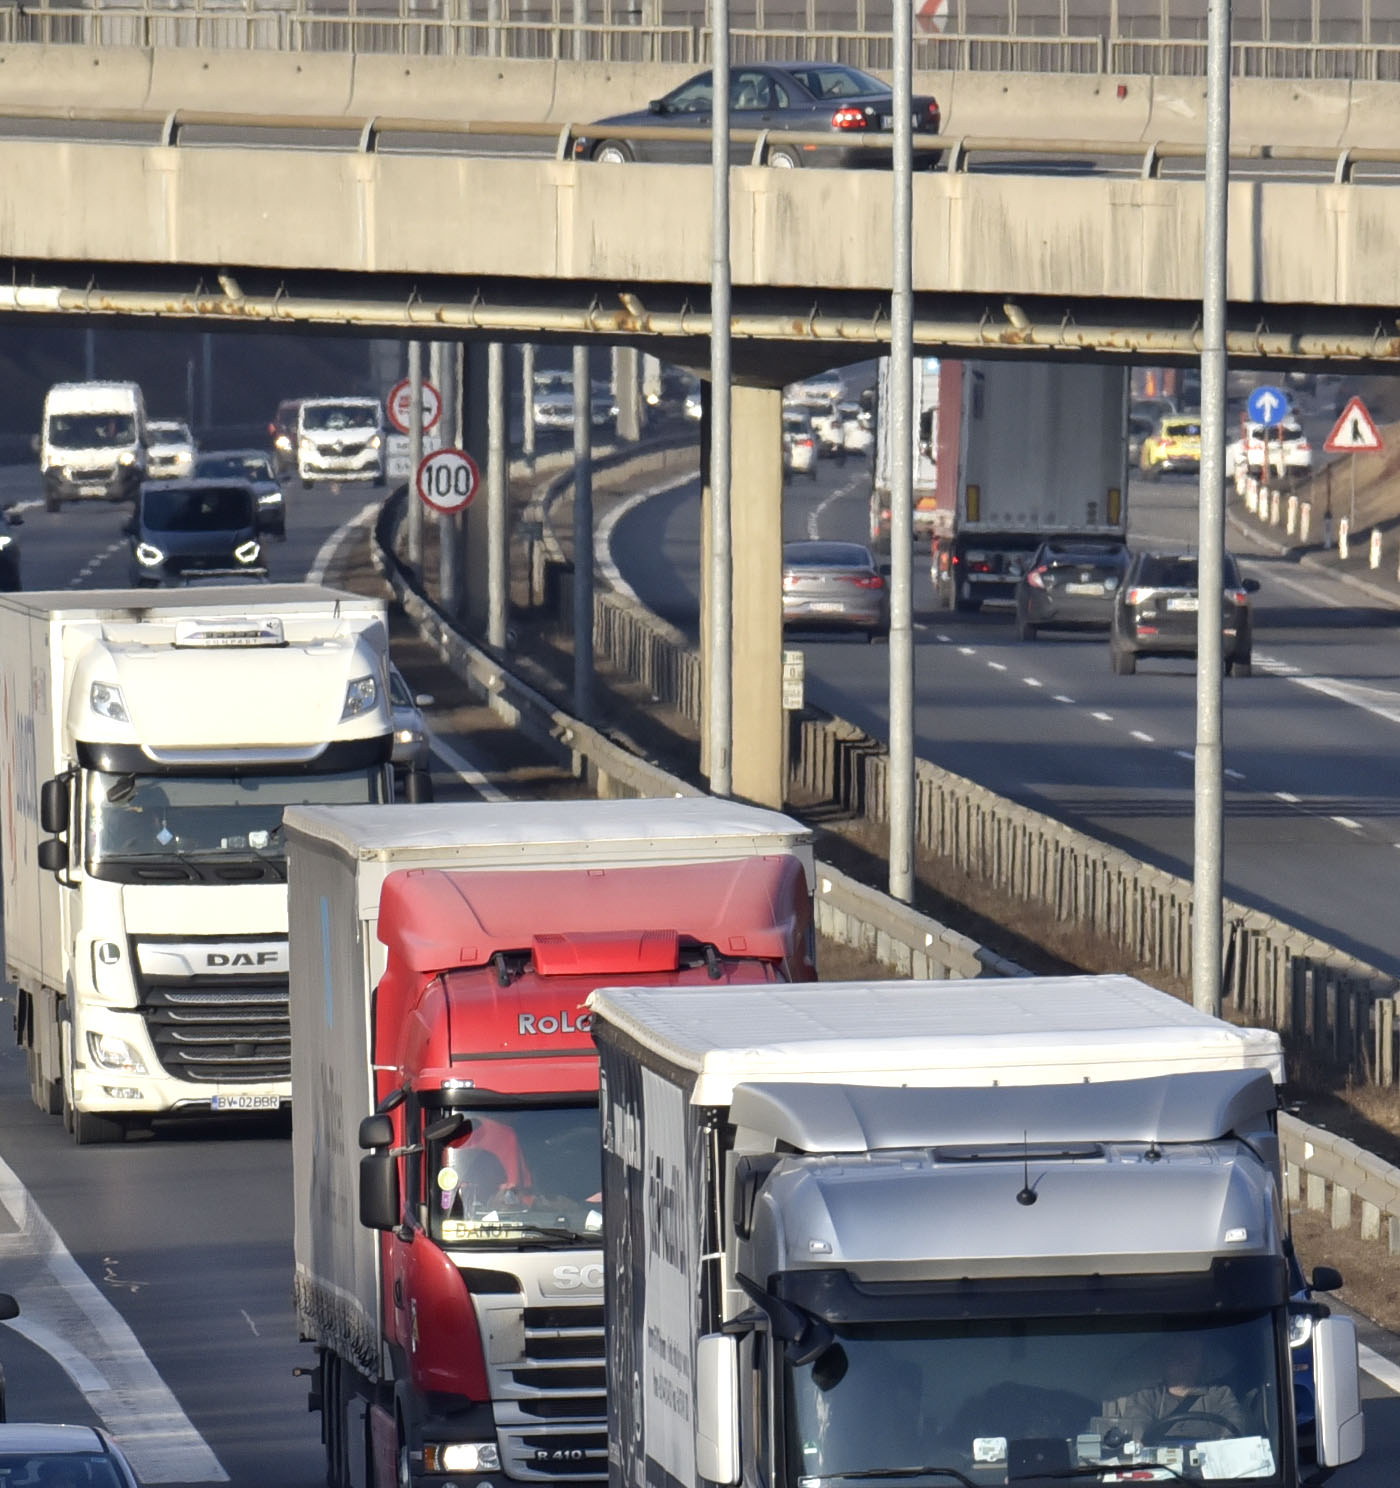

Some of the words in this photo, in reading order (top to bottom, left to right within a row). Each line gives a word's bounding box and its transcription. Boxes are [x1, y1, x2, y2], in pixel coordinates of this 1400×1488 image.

[425, 464, 470, 497] 100
[207, 952, 278, 967] DAF
[537, 1450, 549, 1460] R
[551, 1448, 582, 1460] 410
